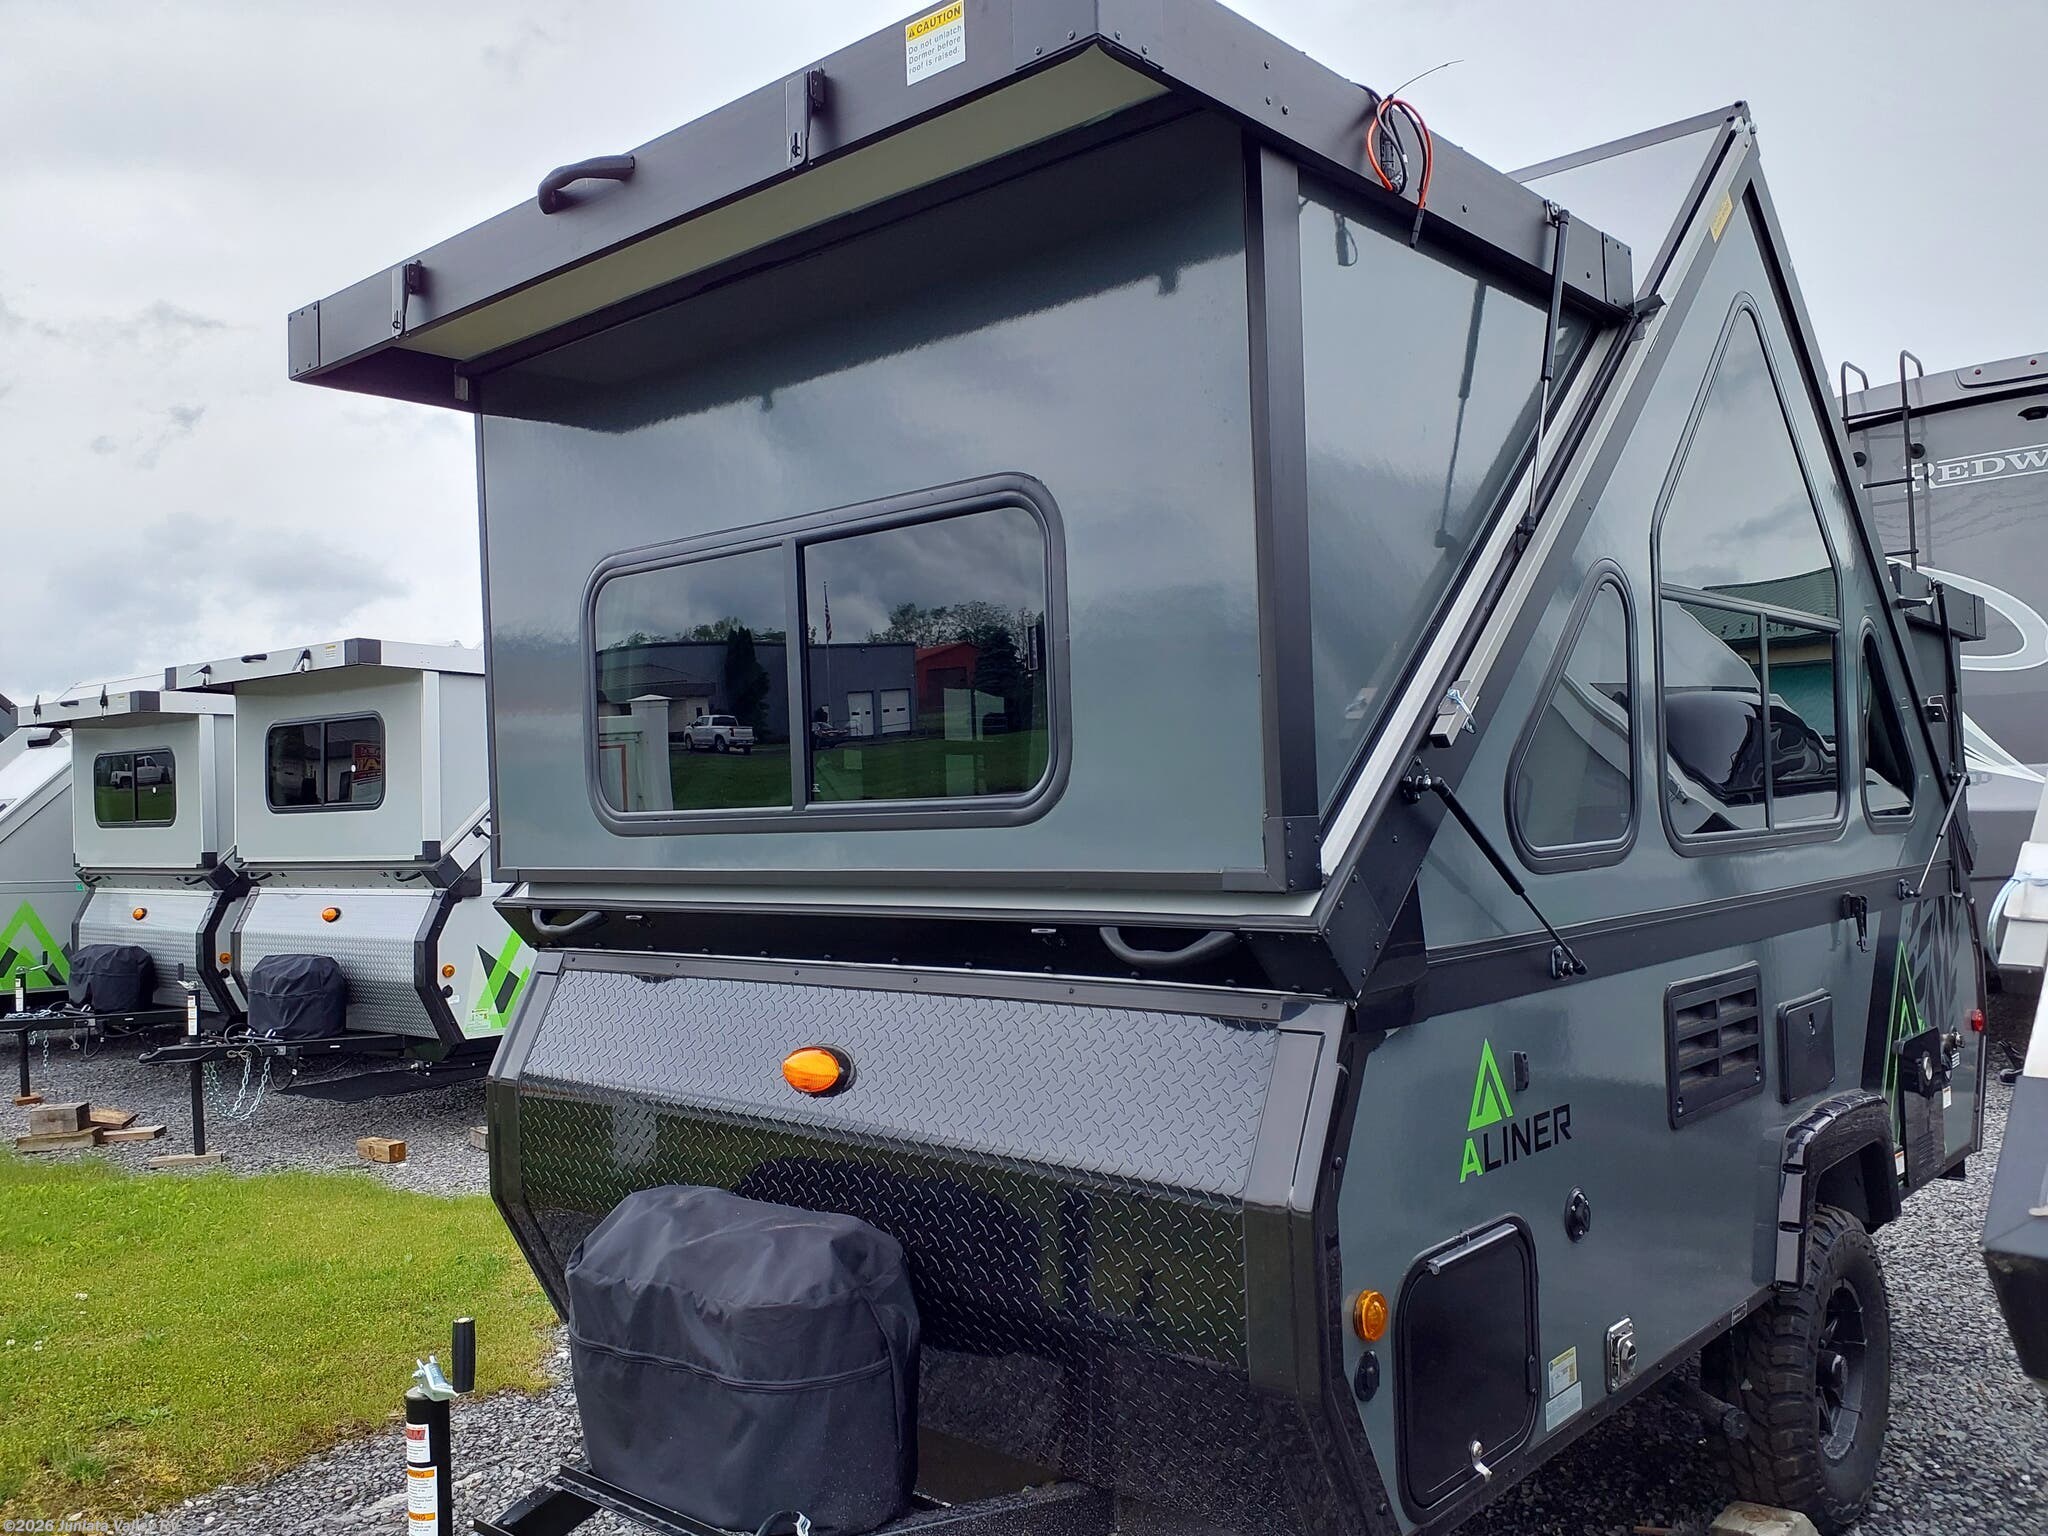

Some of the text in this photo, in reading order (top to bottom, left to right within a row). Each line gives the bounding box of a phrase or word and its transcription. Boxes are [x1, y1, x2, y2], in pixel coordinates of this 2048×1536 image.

[917, 5, 961, 34] CAUTION
[908, 25, 962, 55] Do not unlatch
[908, 36, 961, 65] Dormer before
[909, 47, 960, 75] roof is raised.
[1459, 1103, 1573, 1184] ALINER
